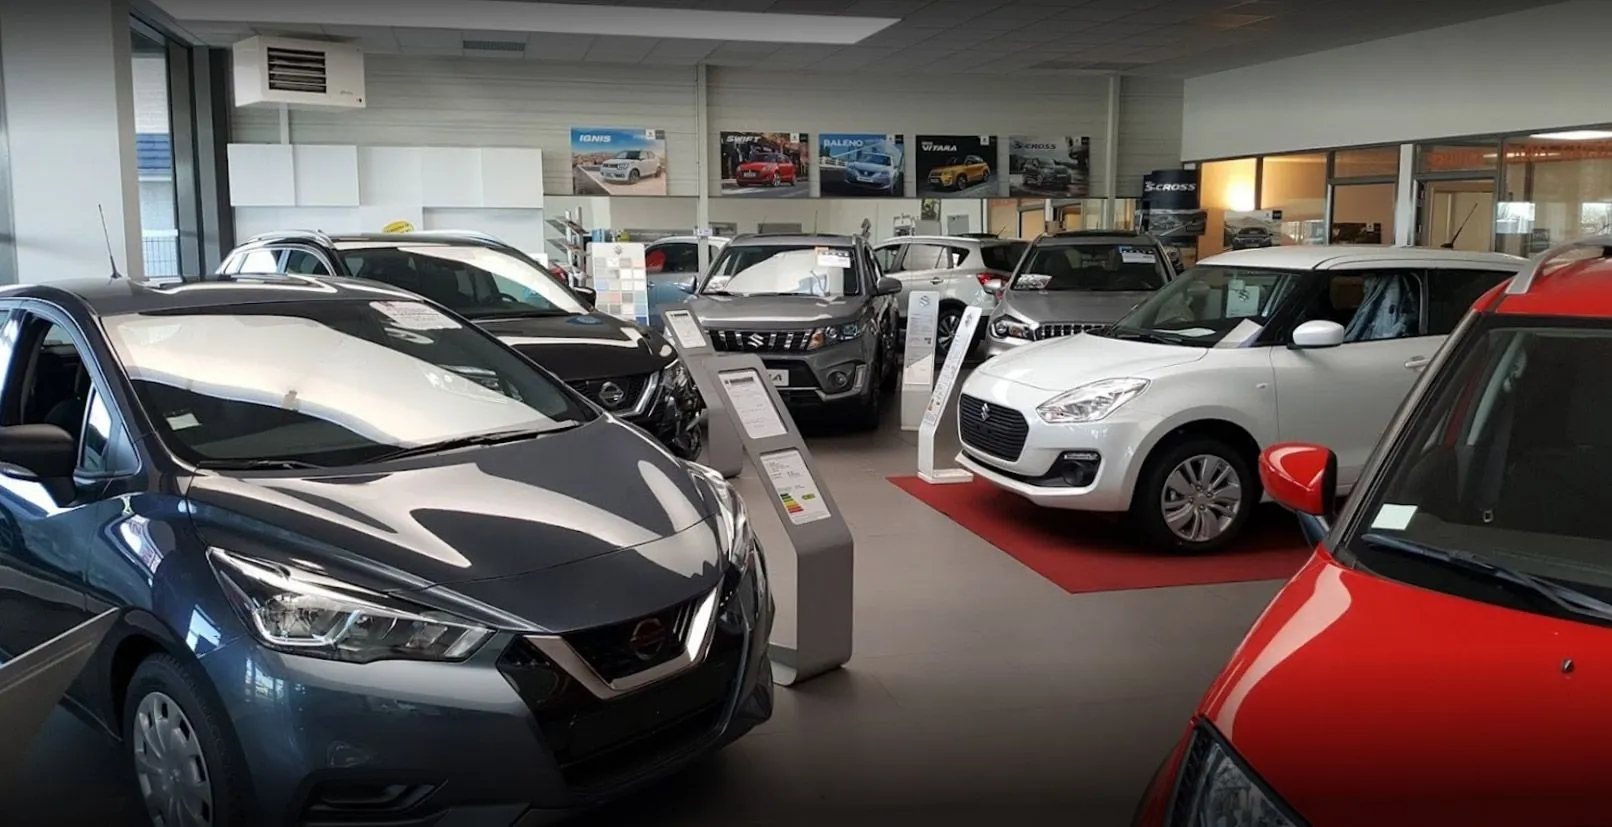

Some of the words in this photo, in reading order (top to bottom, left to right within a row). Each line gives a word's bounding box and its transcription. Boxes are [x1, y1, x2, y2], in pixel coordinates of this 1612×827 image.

[578, 134, 612, 143] IGNIS
[726, 134, 761, 144] SWIFT
[823, 139, 864, 148] BALENO
[1144, 181, 1197, 192] S-CROSS
